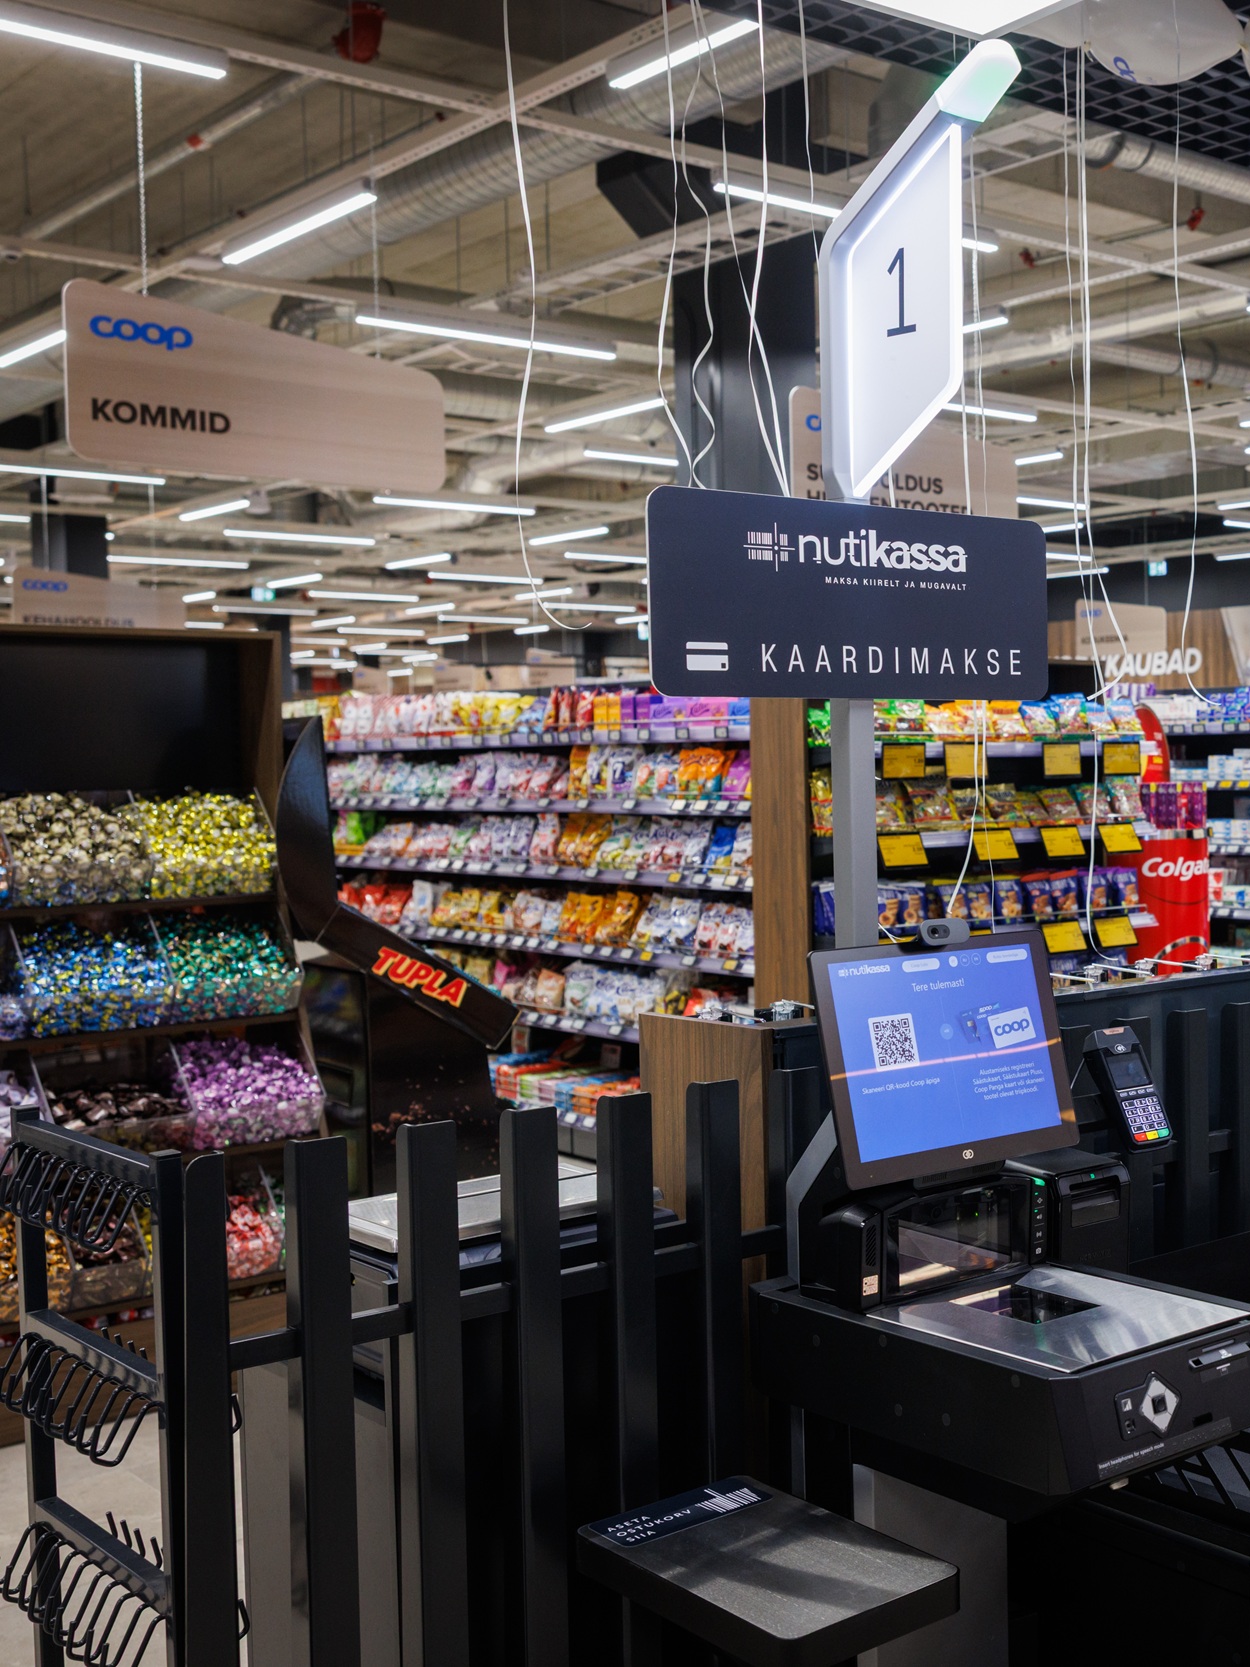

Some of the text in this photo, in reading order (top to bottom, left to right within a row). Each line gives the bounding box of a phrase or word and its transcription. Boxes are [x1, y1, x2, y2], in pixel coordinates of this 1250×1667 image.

[886, 247, 917, 337] 1
[89, 314, 194, 351] coop
[91, 398, 231, 435] KOMMID
[798, 529, 968, 573] nutikassa
[825, 576, 967, 591] MAKSA KIIRELT JA MUGAVALT
[761, 643, 1022, 676] KAARDIMAKSE
[1052, 647, 1203, 678] KAUBAD
[371, 946, 468, 1008] TUPLA
[849, 964, 890, 977] nutikassa
[911, 978, 965, 993] Tere tulemast!
[994, 1018, 1030, 1036] coop
[862, 1077, 940, 1095] Skaneeri QR-kood Coop äpiga
[974, 1086, 988, 1094] Coop
[1098, 1461, 1110, 1469] Insert
[1110, 1453, 1133, 1465] headphones
[607, 1515, 651, 1533] ASETA
[616, 1509, 692, 1537] OSTUKORV
[626, 1530, 657, 1543] SIIA
